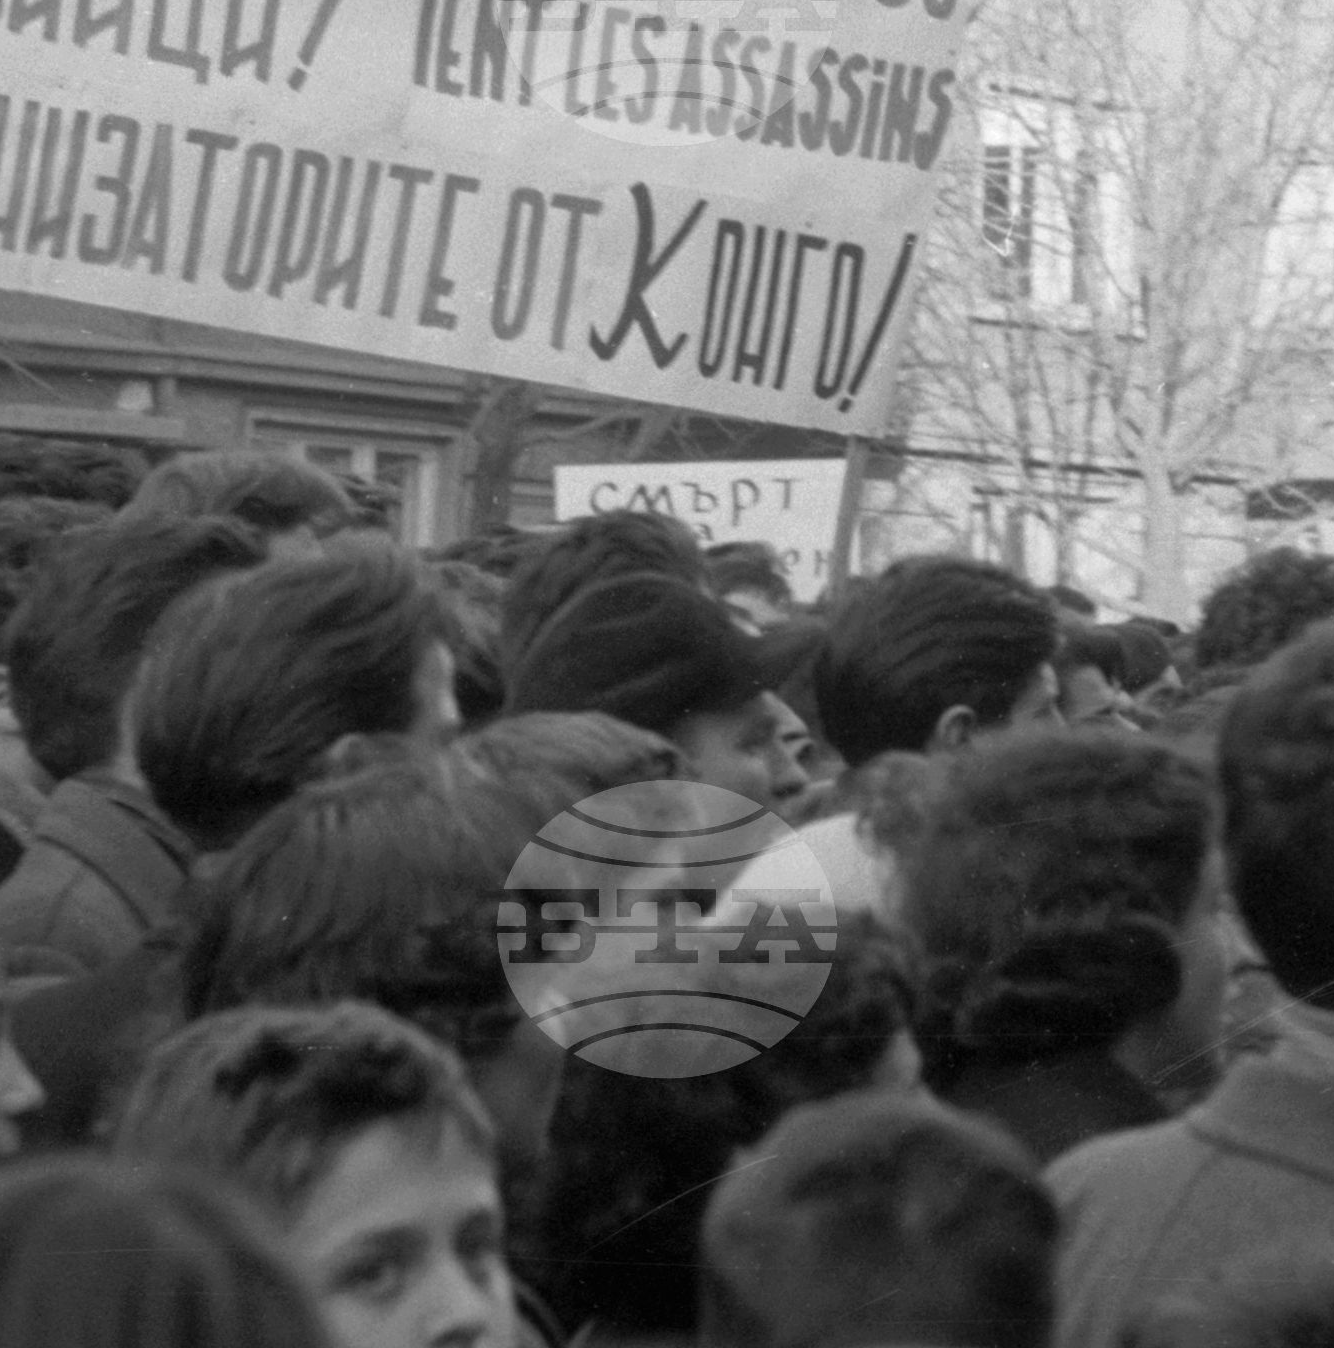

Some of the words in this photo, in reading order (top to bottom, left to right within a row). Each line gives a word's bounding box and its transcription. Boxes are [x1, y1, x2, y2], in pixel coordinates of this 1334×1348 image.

[563, 1, 667, 125] LES
[490, 187, 604, 352] ОТ
[588, 181, 918, 414] КОНГО!
[589, 478, 802, 527] СМЪРТ
